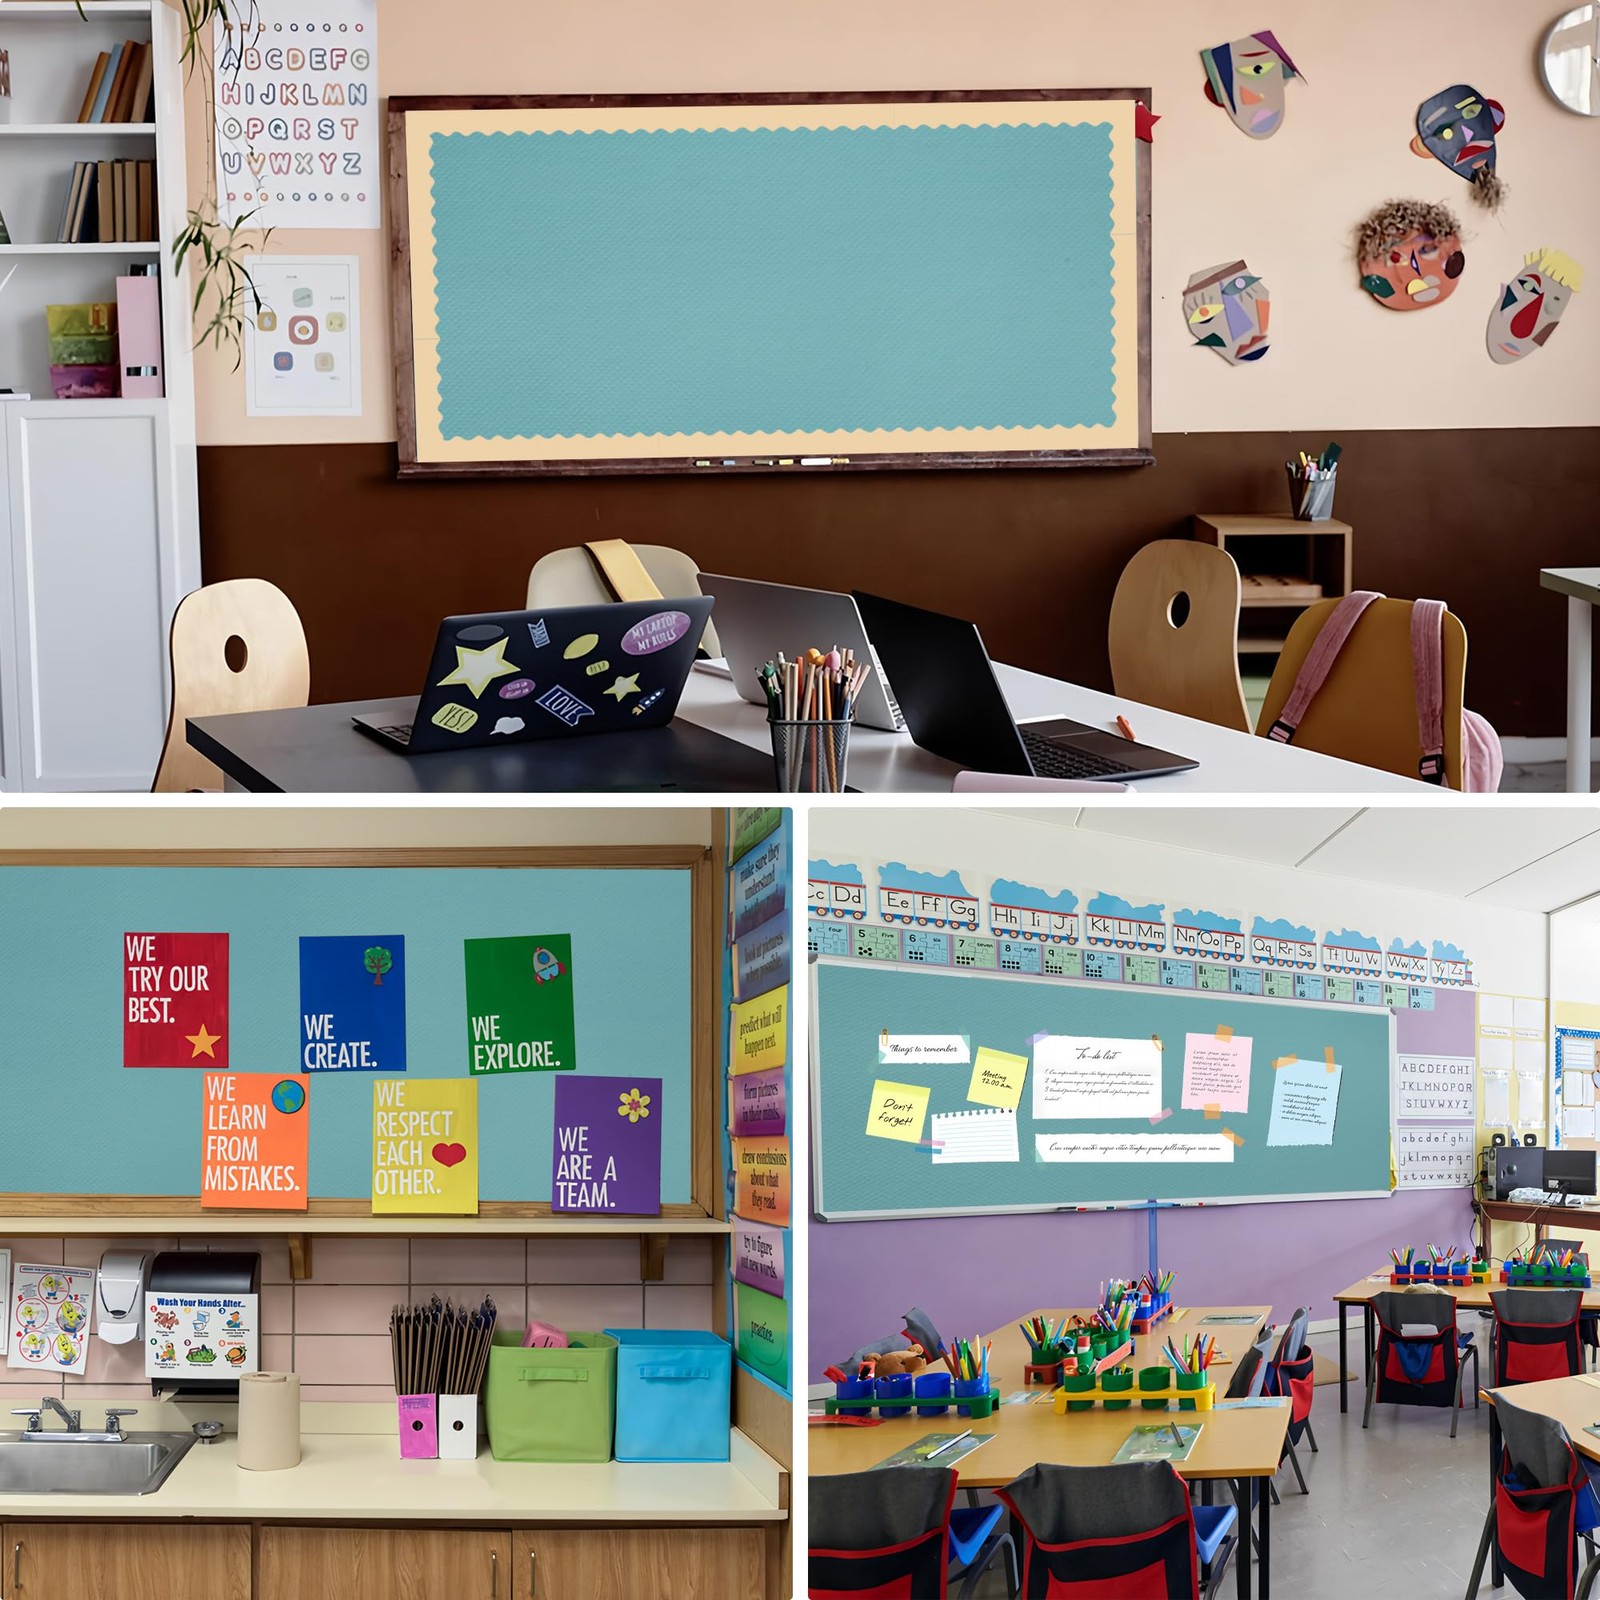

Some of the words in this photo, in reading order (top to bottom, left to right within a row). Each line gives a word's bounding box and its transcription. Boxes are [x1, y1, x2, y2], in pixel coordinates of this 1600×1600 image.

[439, 705, 474, 731] YES!
[545, 691, 582, 720] LOVE
[835, 886, 861, 904] Dd
[887, 892, 909, 908] Ee
[921, 896, 941, 912] Ff
[950, 899, 976, 923] Gg
[858, 929, 866, 938] 5
[994, 907, 1018, 924] Hh
[1031, 912, 1040, 927] Ii
[1053, 916, 1073, 937] Jj
[1091, 917, 1110, 933] Kk
[1138, 923, 1164, 940] Mm
[126, 936, 156, 962] WE
[909, 934, 916, 943] 6
[958, 939, 965, 948] 7
[1005, 944, 1012, 953] 8
[1176, 928, 1195, 943] Nn
[1200, 931, 1220, 946] Oo
[1224, 934, 1241, 954] Pp
[1253, 938, 1274, 958] Qq
[1278, 941, 1293, 955] Rr
[1299, 944, 1312, 957] Ss
[1048, 949, 1055, 958] 9
[1086, 953, 1096, 962] 10
[1326, 947, 1339, 961] Tt
[1345, 950, 1360, 964] Uu
[1366, 952, 1378, 965] Vv
[1388, 955, 1409, 969] Ww
[1411, 959, 1425, 971] Xx
[129, 966, 163, 992] TRY
[169, 965, 209, 991] OUR
[1165, 977, 1174, 985] 12
[1434, 962, 1445, 977] Yy
[1451, 963, 1463, 976] Zz
[129, 997, 175, 1023] BEST.
[304, 1014, 334, 1040] WE
[472, 1015, 501, 1041] WE
[740, 1015, 759, 1040] predict
[304, 1041, 377, 1069] CREATE.
[474, 1041, 561, 1071] EXPLORE.
[745, 1038, 764, 1057] happen
[889, 1044, 913, 1056] Things
[923, 1045, 958, 1053] remember
[1103, 1050, 1122, 1060] list
[981, 1069, 1007, 1082] Meeting
[207, 1076, 236, 1101] WE
[376, 1081, 405, 1107] WE
[883, 1098, 914, 1110] Don't
[208, 1104, 266, 1130] LEARN
[376, 1111, 453, 1137] RESPECT
[878, 1111, 913, 1127] forget!
[207, 1136, 258, 1162] FROM
[559, 1126, 588, 1152] WE
[377, 1140, 423, 1166] EACH
[204, 1165, 300, 1191] MISTAKES.
[556, 1154, 592, 1180] ARE
[604, 1156, 617, 1181] A
[751, 1168, 765, 1186] about
[375, 1169, 442, 1195] OTHER.
[556, 1182, 616, 1208] TEAM.
[157, 1298, 178, 1306] Wash
[179, 1299, 196, 1307] Your
[197, 1299, 222, 1307] Hands
